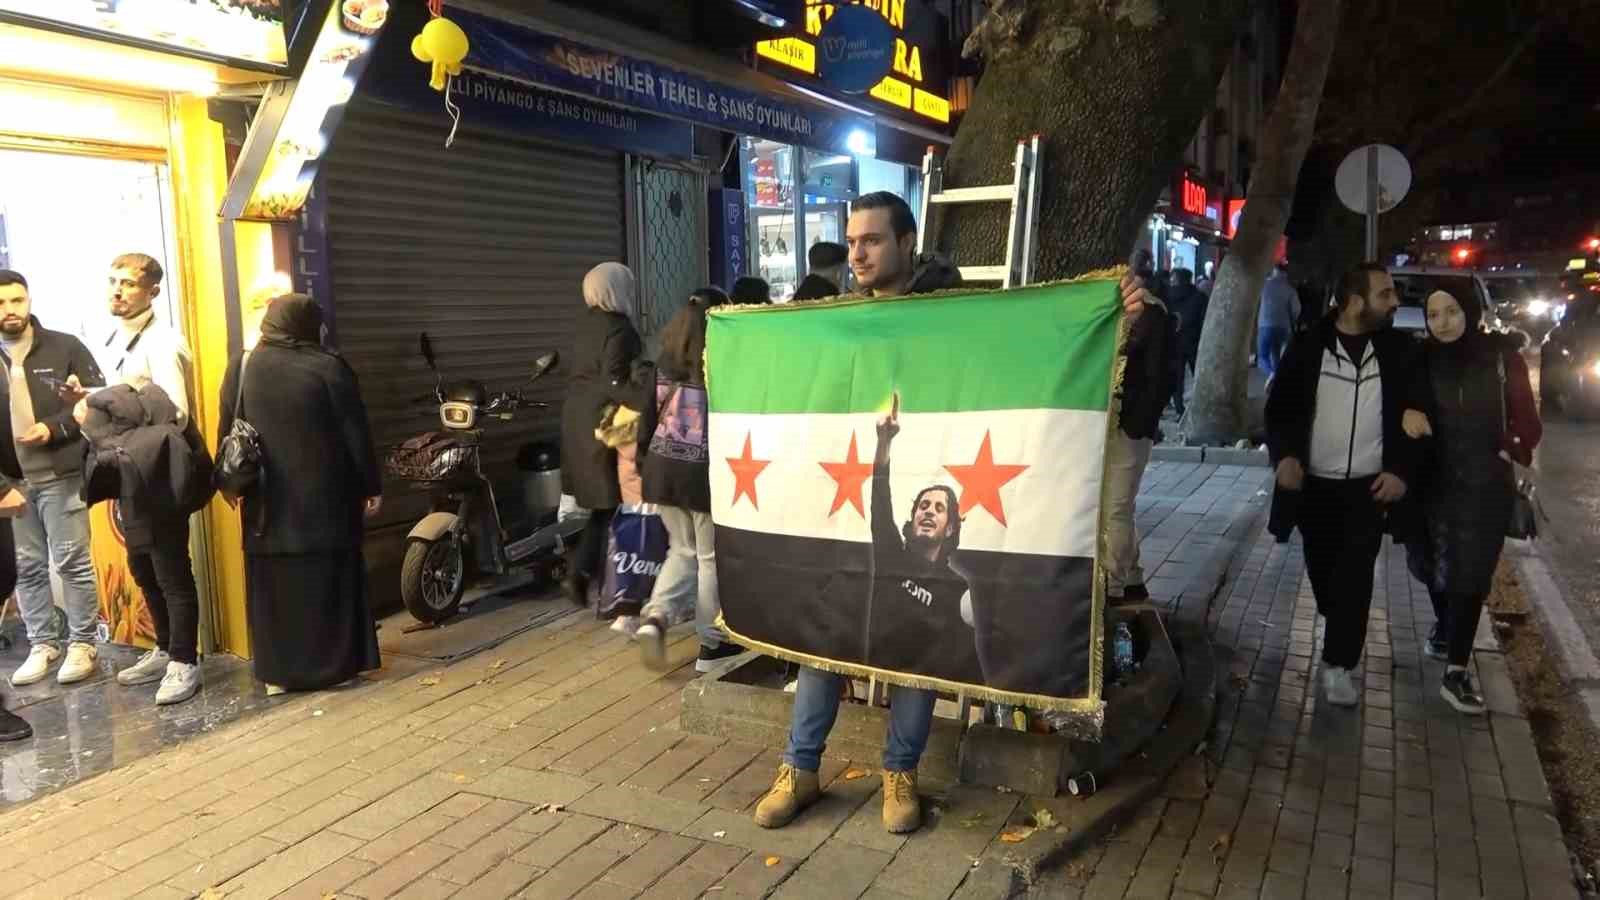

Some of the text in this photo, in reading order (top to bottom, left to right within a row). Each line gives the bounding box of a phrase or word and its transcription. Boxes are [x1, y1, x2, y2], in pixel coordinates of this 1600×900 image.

[474, 81, 533, 111] PİYANGO
[536, 99, 545, 112] &
[583, 108, 637, 132] OYUNLARI
[566, 52, 812, 137] SEVENLER TEKEL & ŞANS OYUNLARI
